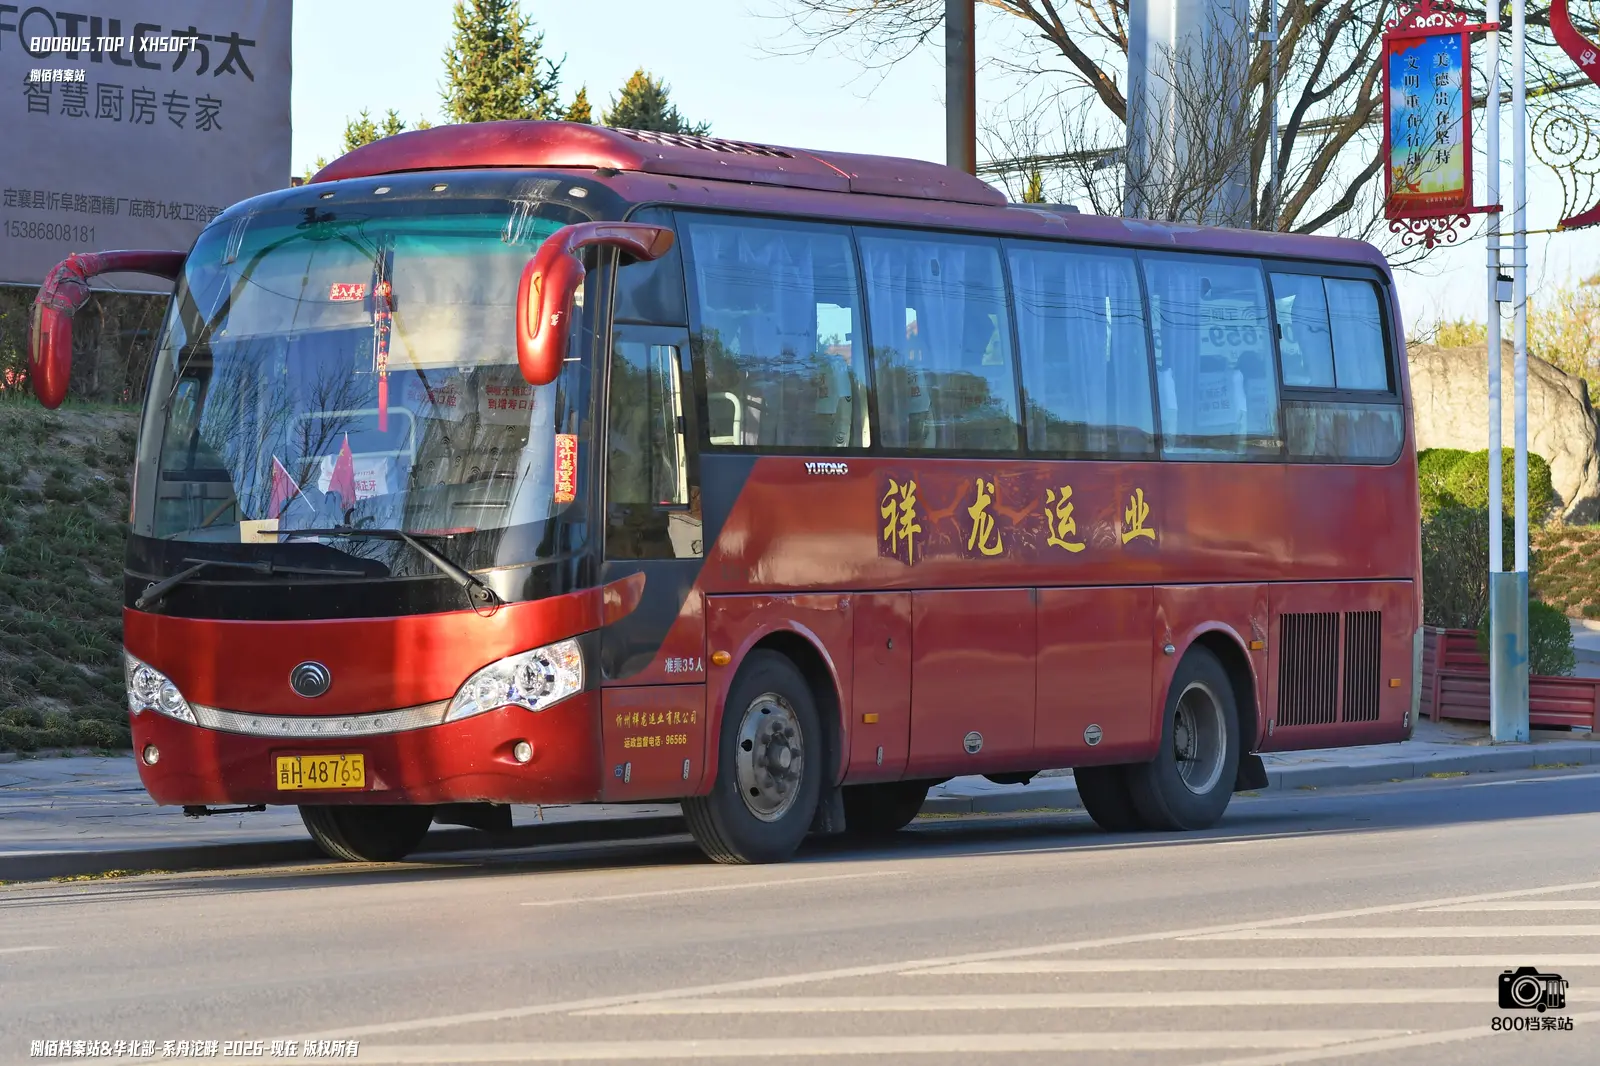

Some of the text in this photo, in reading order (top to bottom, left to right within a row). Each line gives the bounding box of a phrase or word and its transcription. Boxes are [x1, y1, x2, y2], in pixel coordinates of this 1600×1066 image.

[171, 25, 256, 82] 方太
[23, 72, 222, 132] 智慧厨房专家
[3, 188, 226, 224] 定襄县忻阜路酒精厂底商九牧卫浴旁
[4, 220, 96, 243] 15386808181
[804, 462, 848, 475] YUTONG
[880, 477, 1156, 567] 祥龙运业
[664, 658, 704, 673] 准乘35人
[616, 710, 697, 728] 忻州祥龙运业有限公司
[665, 734, 687, 745] 96566
